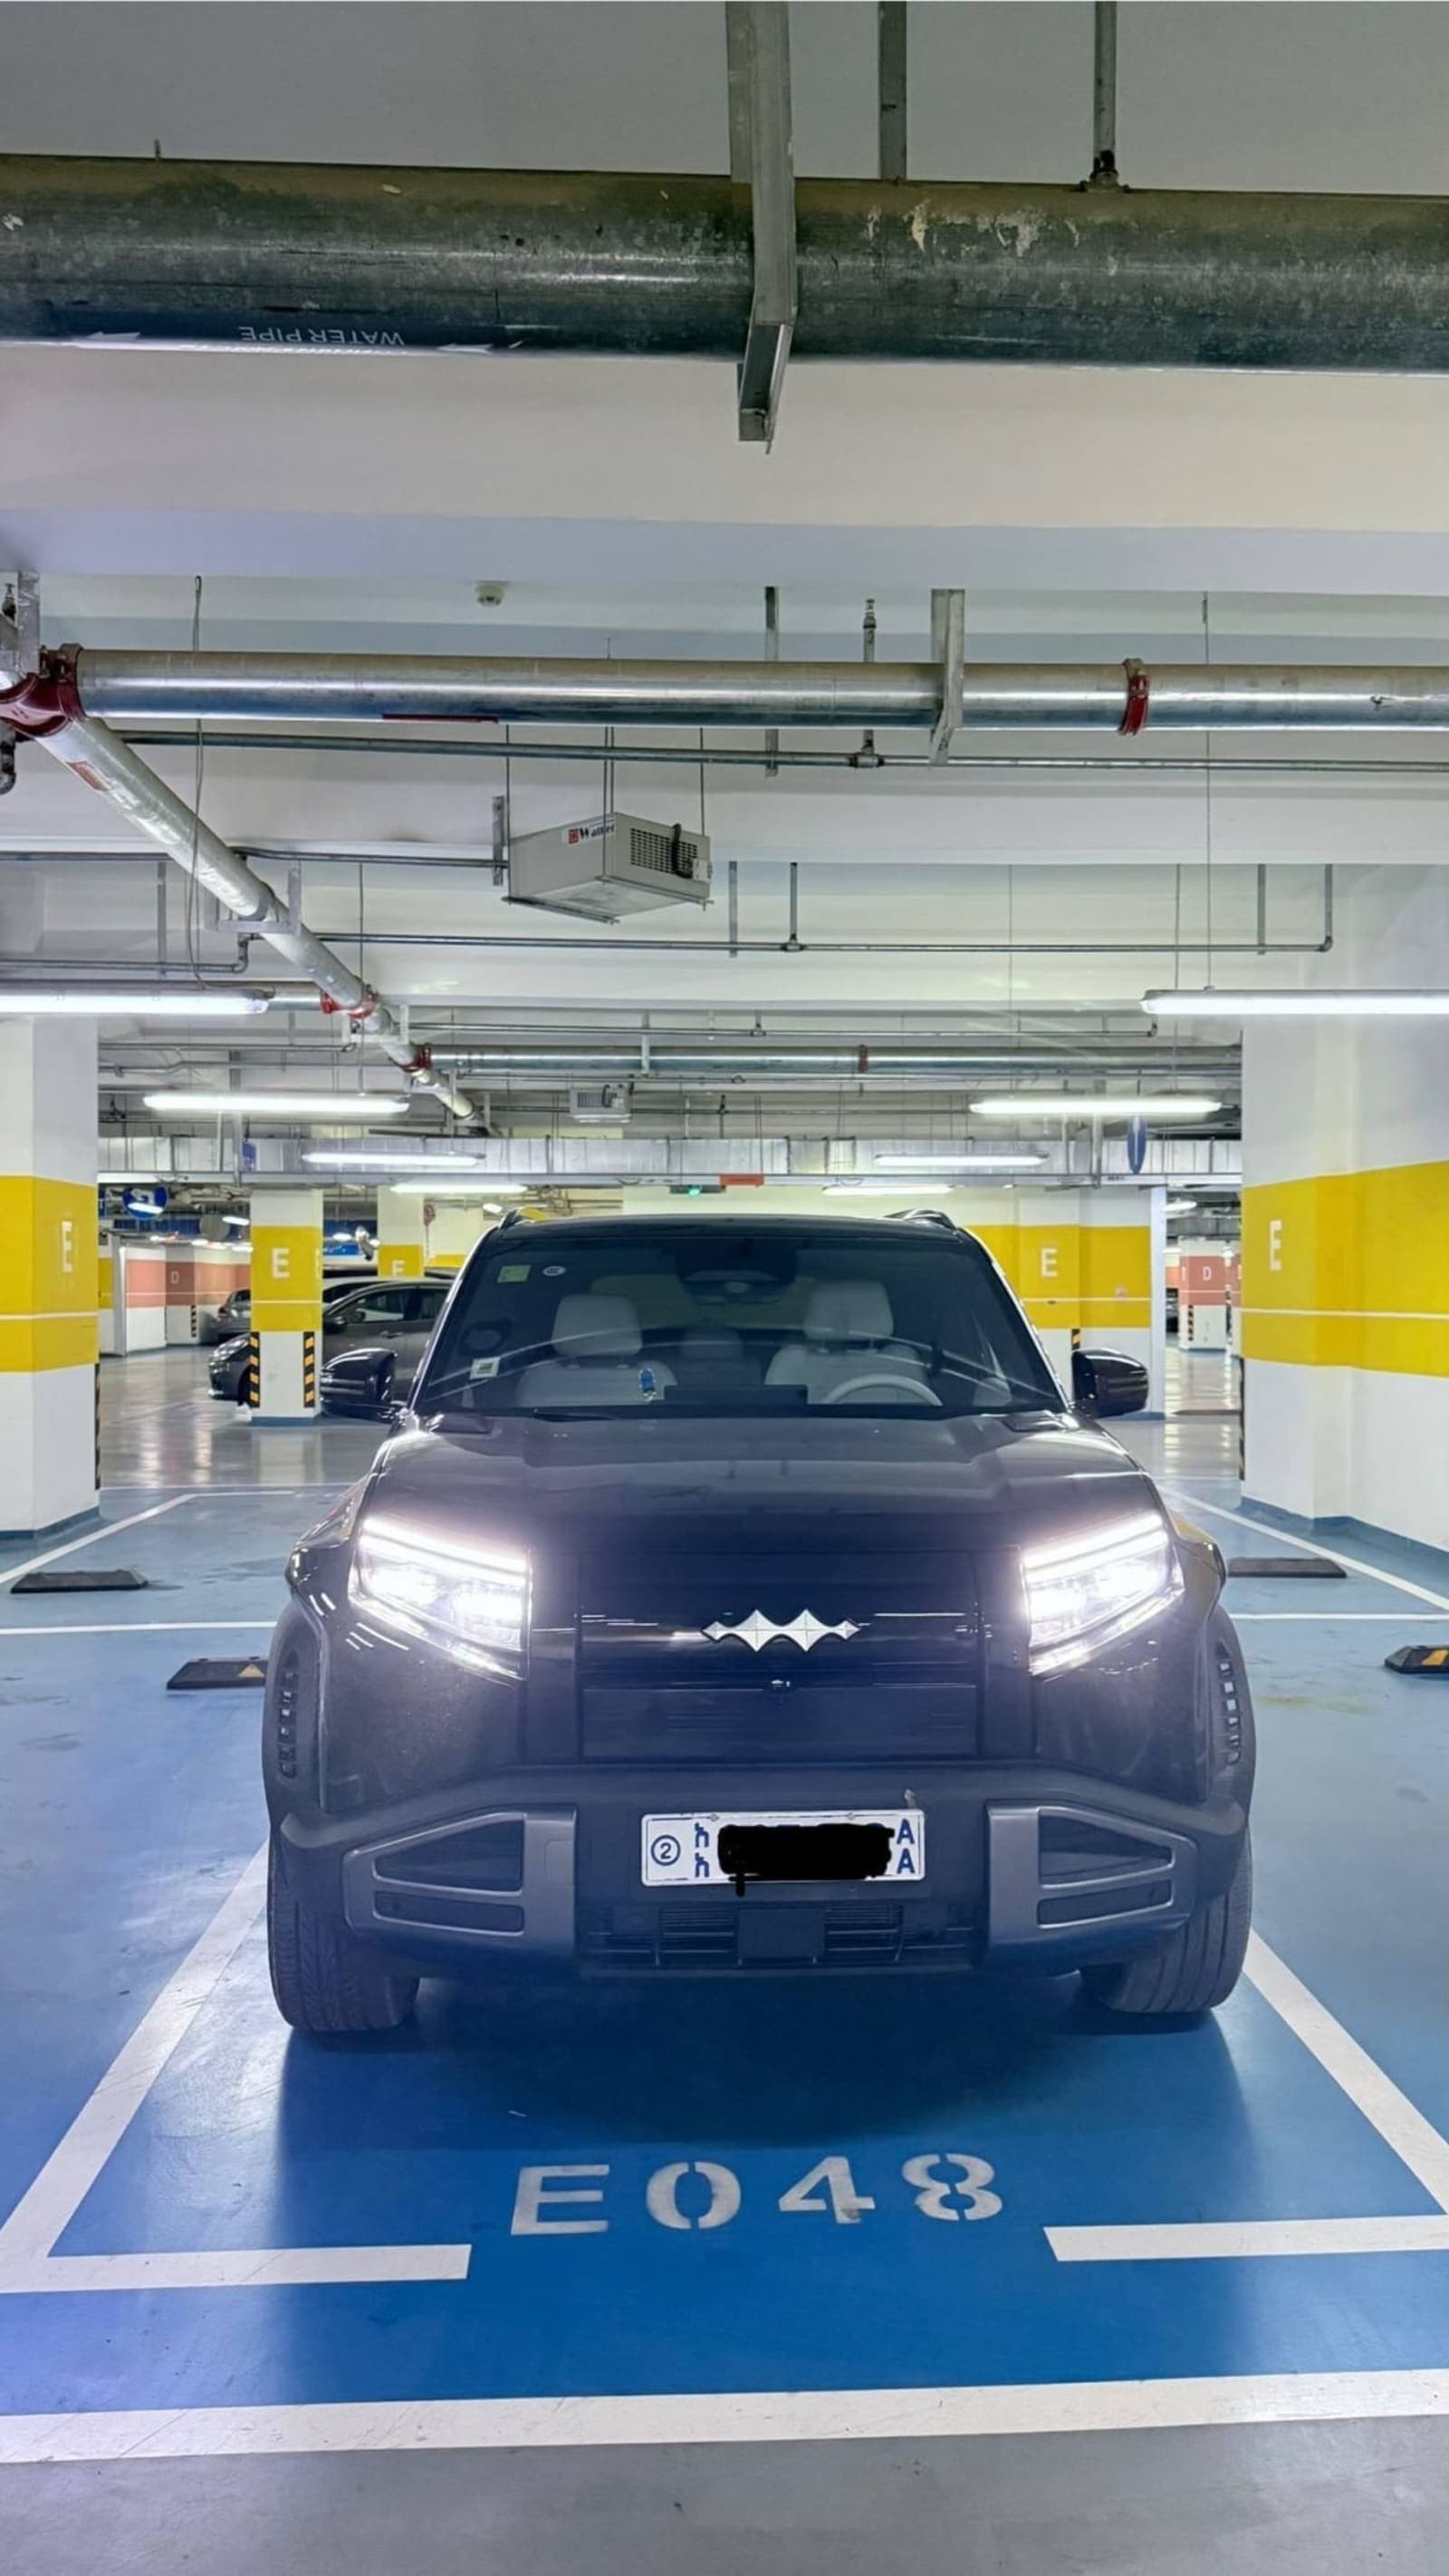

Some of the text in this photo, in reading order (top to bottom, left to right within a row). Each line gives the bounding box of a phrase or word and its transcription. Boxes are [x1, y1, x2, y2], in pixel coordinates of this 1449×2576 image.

[238, 325, 406, 346] WATER PIPE
[61, 1220, 73, 1274] E
[1270, 1219, 1282, 1272] E
[170, 1270, 180, 1284] D
[272, 1247, 291, 1279] E
[1041, 1247, 1059, 1278] E
[1202, 1265, 1213, 1282] D
[510, 2152, 1004, 2236] E048
